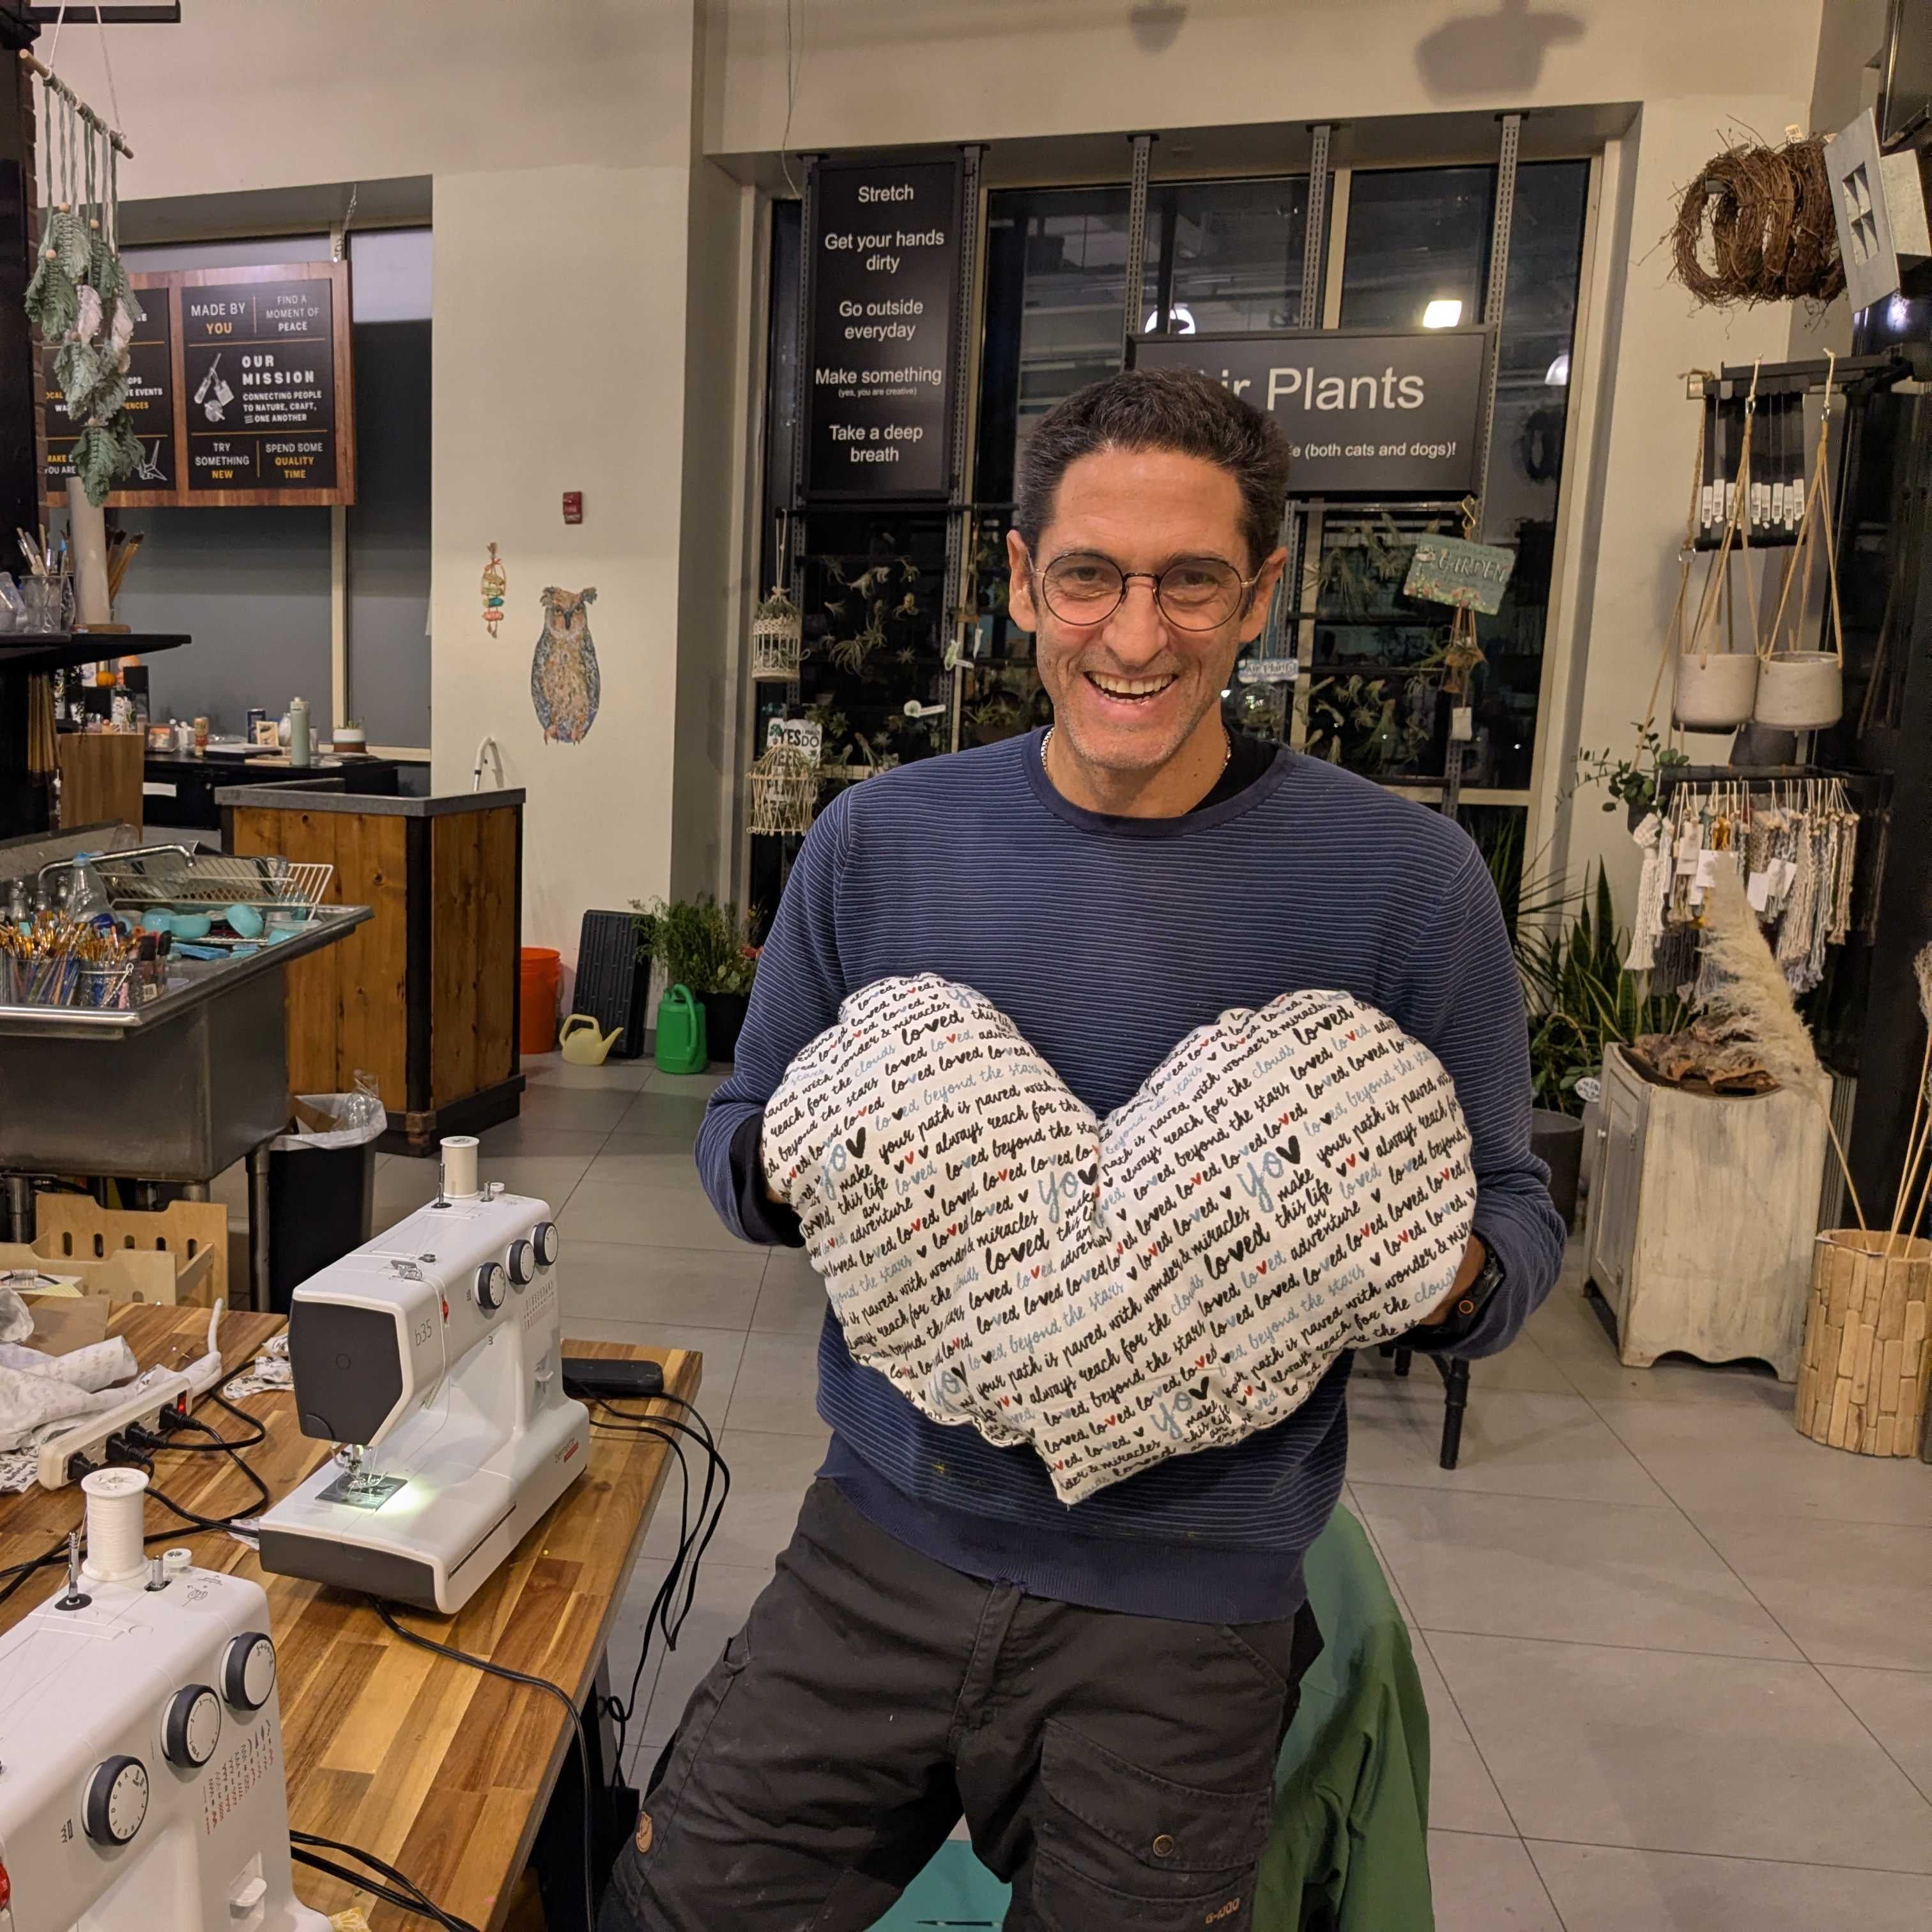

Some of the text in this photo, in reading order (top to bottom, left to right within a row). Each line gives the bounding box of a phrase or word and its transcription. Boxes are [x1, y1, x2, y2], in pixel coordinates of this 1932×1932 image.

[858, 185, 914, 203] Stretch
[825, 229, 944, 252] Get your hands
[866, 255, 900, 274] dirty
[192, 302, 246, 316] MADE BY
[277, 295, 307, 305] FIND A
[839, 298, 923, 318] Go outside
[266, 307, 319, 319] MOMENT OF
[206, 322, 233, 335] YOU
[278, 322, 307, 332] PEACE
[844, 322, 916, 342] everyday
[241, 355, 275, 368] OUR
[242, 371, 314, 385] MISSION
[815, 367, 942, 385] Make something
[135, 388, 163, 397] EVENTS
[243, 390, 322, 401] CONNECTING PEOPLE
[838, 388, 855, 397] (yes,
[857, 389, 871, 397] you
[1267, 366, 1425, 411] Plants
[243, 402, 317, 412] TO NATURE, CRAFT,
[254, 414, 270, 423] ONE
[272, 413, 307, 422] ANOTHER
[829, 424, 923, 443] Take a deep
[213, 442, 231, 452] TRY
[265, 442, 323, 453] SPEND SOME
[850, 447, 899, 463] breath
[1305, 442, 1341, 460] (both
[1345, 442, 1374, 457] cats
[1379, 441, 1406, 457] and
[1410, 441, 1456, 459] dogs)!
[61, 466, 76, 474] ARE
[195, 456, 250, 466] SOMETHING
[275, 456, 314, 466] QUALITY
[211, 470, 233, 479] NEW
[284, 470, 306, 479] TIME
[780, 728, 801, 746] YES
[801, 735, 819, 747] DO
[802, 1074, 833, 1094] with
[836, 1036, 879, 1075] wonder
[892, 1002, 950, 1031] miracles
[1347, 1041, 1390, 1071] loved
[939, 1046, 983, 1071] loved
[770, 1009, 964, 1137] reach for the clouds loved
[924, 1063, 1041, 1105] beyond the stars
[1121, 1005, 1354, 1183] always reach for the clouds loved
[778, 1046, 927, 1162] beyond the stars loved
[1101, 1146, 1133, 1176] path
[1133, 1135, 1145, 1147] is
[1148, 1102, 1190, 1138] paved
[1192, 1073, 1221, 1103] with
[1222, 1036, 1269, 1073] wonder
[1174, 1128, 1230, 1167] beyond
[1229, 1110, 1254, 1131] the
[1254, 1082, 1291, 1113] stars
[1289, 1046, 1333, 1080] loved
[878, 1080, 1057, 1165] your path is paved with
[935, 1098, 1080, 1154] always reach for the
[1316, 1077, 1437, 1169] your path is paved
[1376, 1099, 1447, 1158] always reach
[992, 1128, 1046, 1160] beyond
[1048, 1120, 1073, 1139] the
[839, 1164, 873, 1193] make
[1277, 1169, 1314, 1202] make
[838, 1174, 889, 1215] this life
[941, 1181, 979, 1216] loved
[1275, 1178, 1332, 1229] this life
[1387, 1186, 1429, 1222] loved
[850, 1197, 913, 1244] adventure
[862, 1202, 880, 1219] an
[1306, 1208, 1326, 1229] an
[1291, 1200, 1361, 1261] adventure
[976, 1210, 1050, 1275] miracles loved
[1191, 1206, 1271, 1280] miracles loved
[976, 1375, 1006, 1401] your
[1007, 1355, 1043, 1391] path
[1044, 1352, 1059, 1368] is
[1062, 1323, 1107, 1368] paved
[1108, 1296, 1142, 1331] with
[1143, 1258, 1184, 1305] wonder
